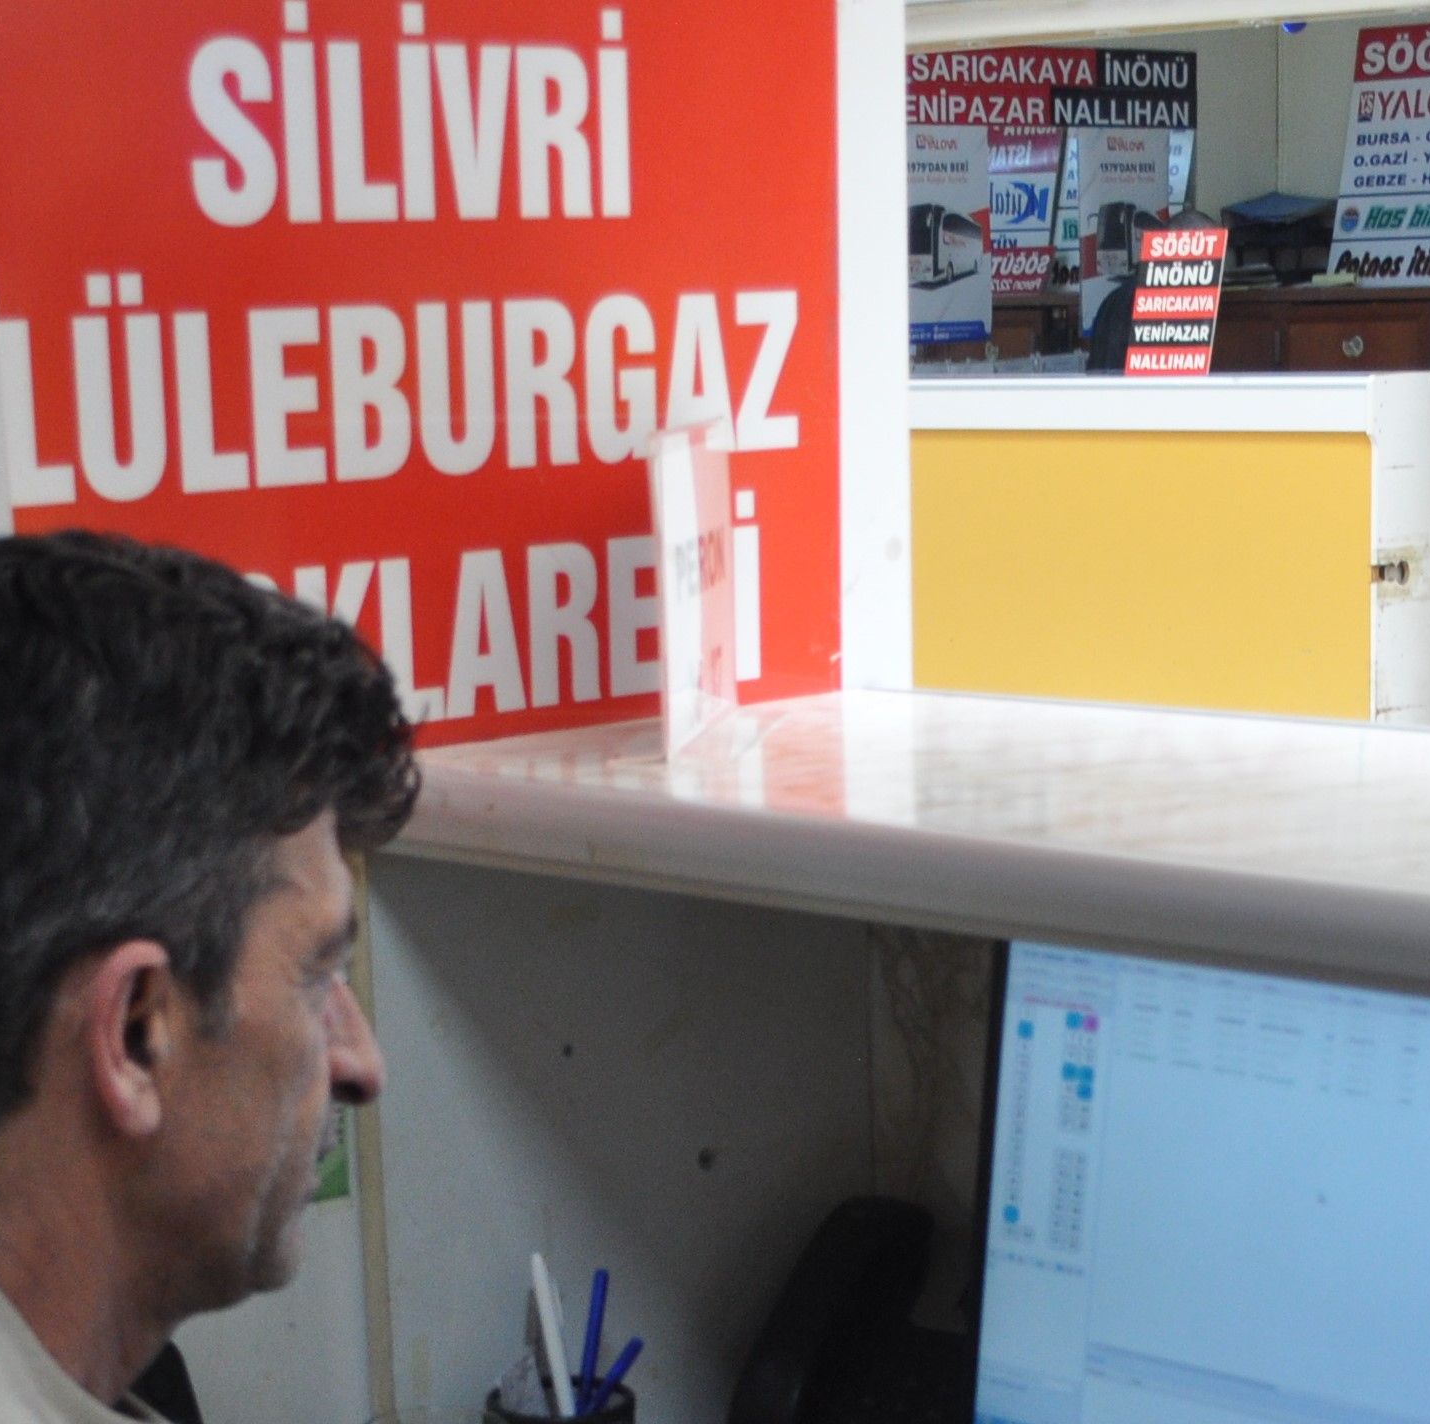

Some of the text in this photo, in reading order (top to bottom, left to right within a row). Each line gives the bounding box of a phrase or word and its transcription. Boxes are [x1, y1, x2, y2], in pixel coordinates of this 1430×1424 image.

[911, 53, 1095, 86] SARICAKAYA
[1104, 52, 1190, 88] İNÖNÜ
[188, 0, 632, 228] SİLİVRİ
[1053, 98, 1191, 127] NALLIHAN
[1356, 132, 1411, 147] BURSA
[1353, 152, 1409, 168] O.GAZİ
[1353, 174, 1407, 189] GEBZE
[1150, 230, 1219, 258] SÖĞÜT
[1145, 260, 1215, 287] İNÖNÜ
[1135, 294, 1214, 313] SARICAKAYA
[1133, 321, 1210, 342] YENİPAZAR
[1129, 353, 1206, 371] NALLIHAN
